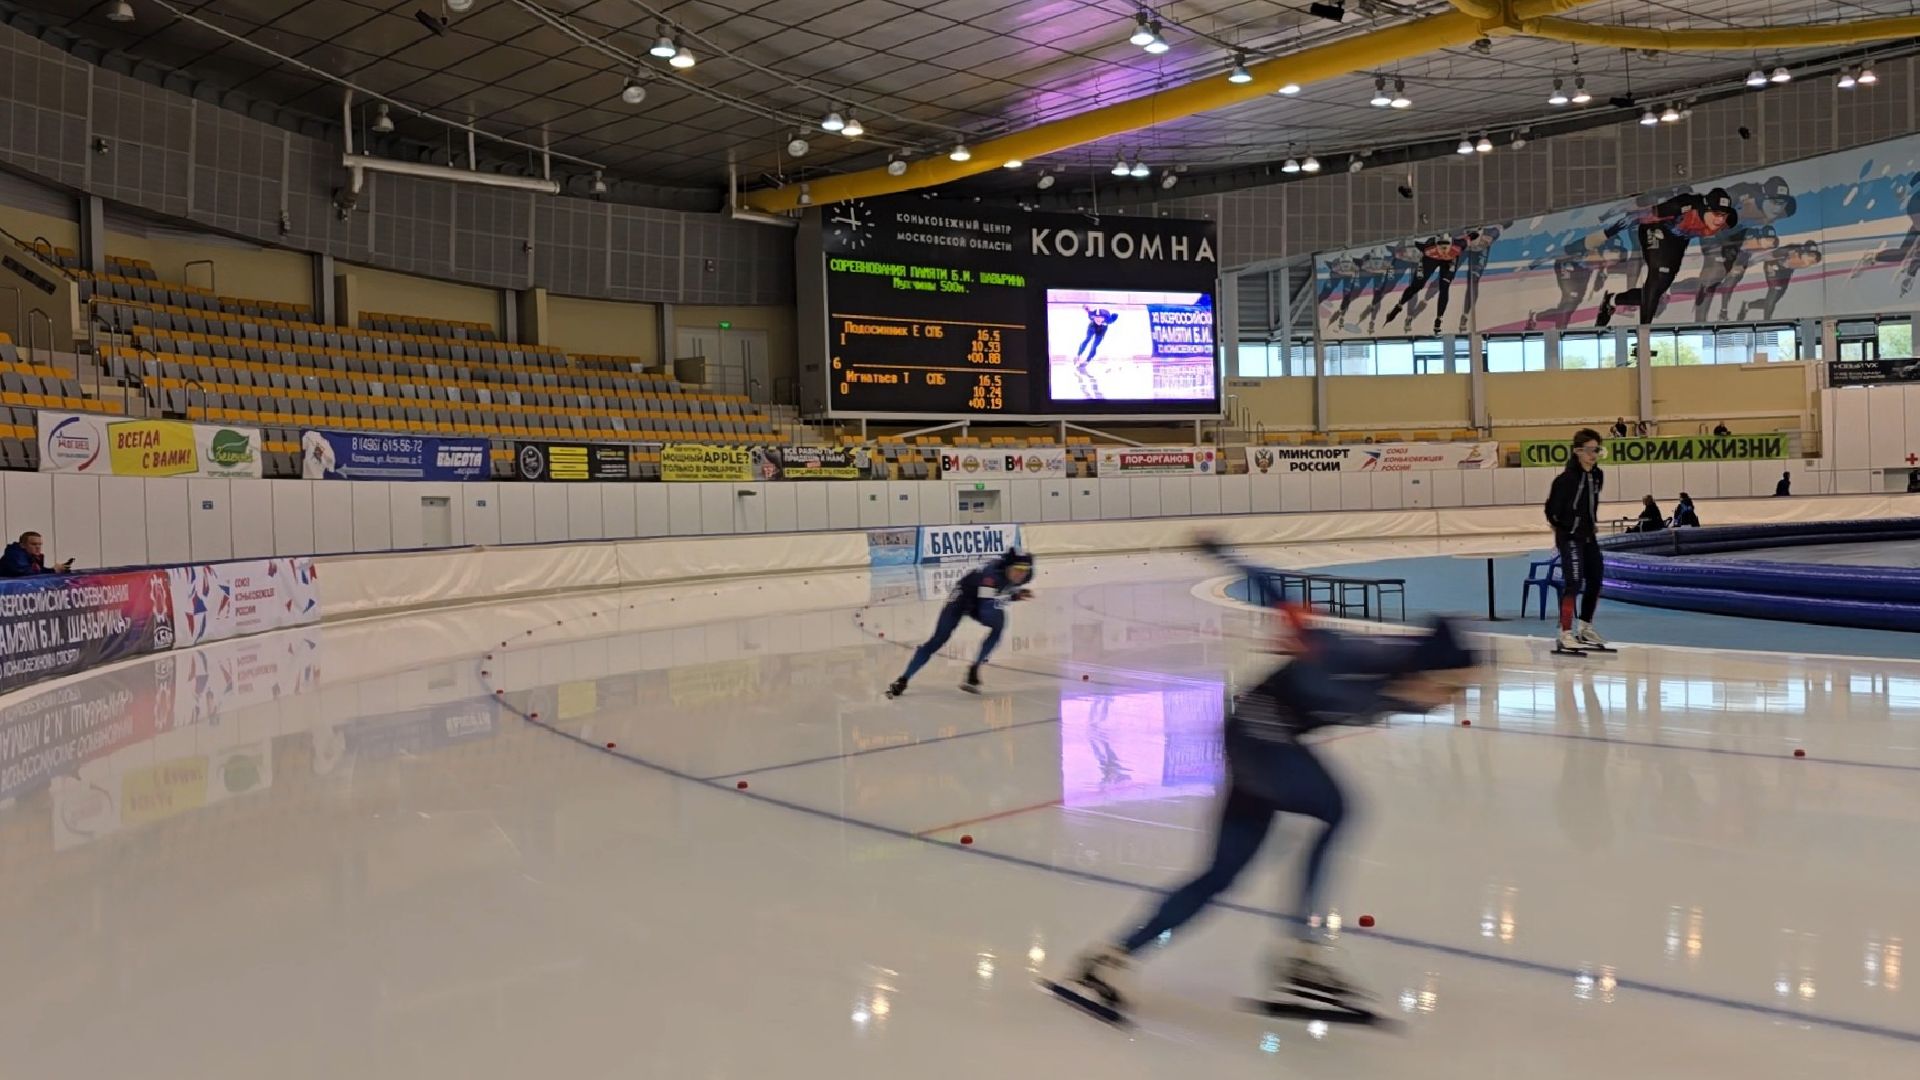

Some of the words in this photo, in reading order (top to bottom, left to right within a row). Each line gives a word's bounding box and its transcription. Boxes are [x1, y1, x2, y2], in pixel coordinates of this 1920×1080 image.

[896, 213, 980, 230] КОНЬКОБЕЖНЫЙ
[983, 223, 1012, 234] ЦЕНТР
[896, 232, 967, 247] МОСКОВСКОЙ
[969, 238, 1012, 251] ОБЛАСТИ
[1031, 227, 1216, 263] КОЛОМНА
[830, 258, 907, 277] СОРЕВНОВАНИЯ
[909, 266, 948, 280] ПАМЯТИ
[951, 269, 975, 282] Б.И.
[925, 325, 943, 338] СПБ
[977, 329, 1001, 341] 16.5
[833, 357, 842, 369] 6
[926, 373, 946, 385] СПБ
[979, 375, 1002, 387] 16.5
[973, 386, 1002, 398] 10.24
[117, 429, 160, 449] ВСЕГДА
[352, 437, 358, 450] 8
[382, 438, 423, 452] 615-56-72
[143, 452, 150, 468] С
[153, 449, 192, 468] ВАМИ!
[662, 452, 703, 463] МОЩНЫЙ
[703, 451, 750, 464] APPLE?
[1278, 449, 1351, 459] МИНСПОРТ
[1527, 444, 1575, 463] СПО
[1612, 440, 1693, 462] НОРМА
[1699, 438, 1782, 459] ЖИЗНИ
[1290, 462, 1341, 472] РОССИИ
[930, 526, 1004, 555] БАССЕЙН
[0, 587, 72, 616] СЕРОССИЙСКИЕ
[39, 617, 65, 648] Б.И.
